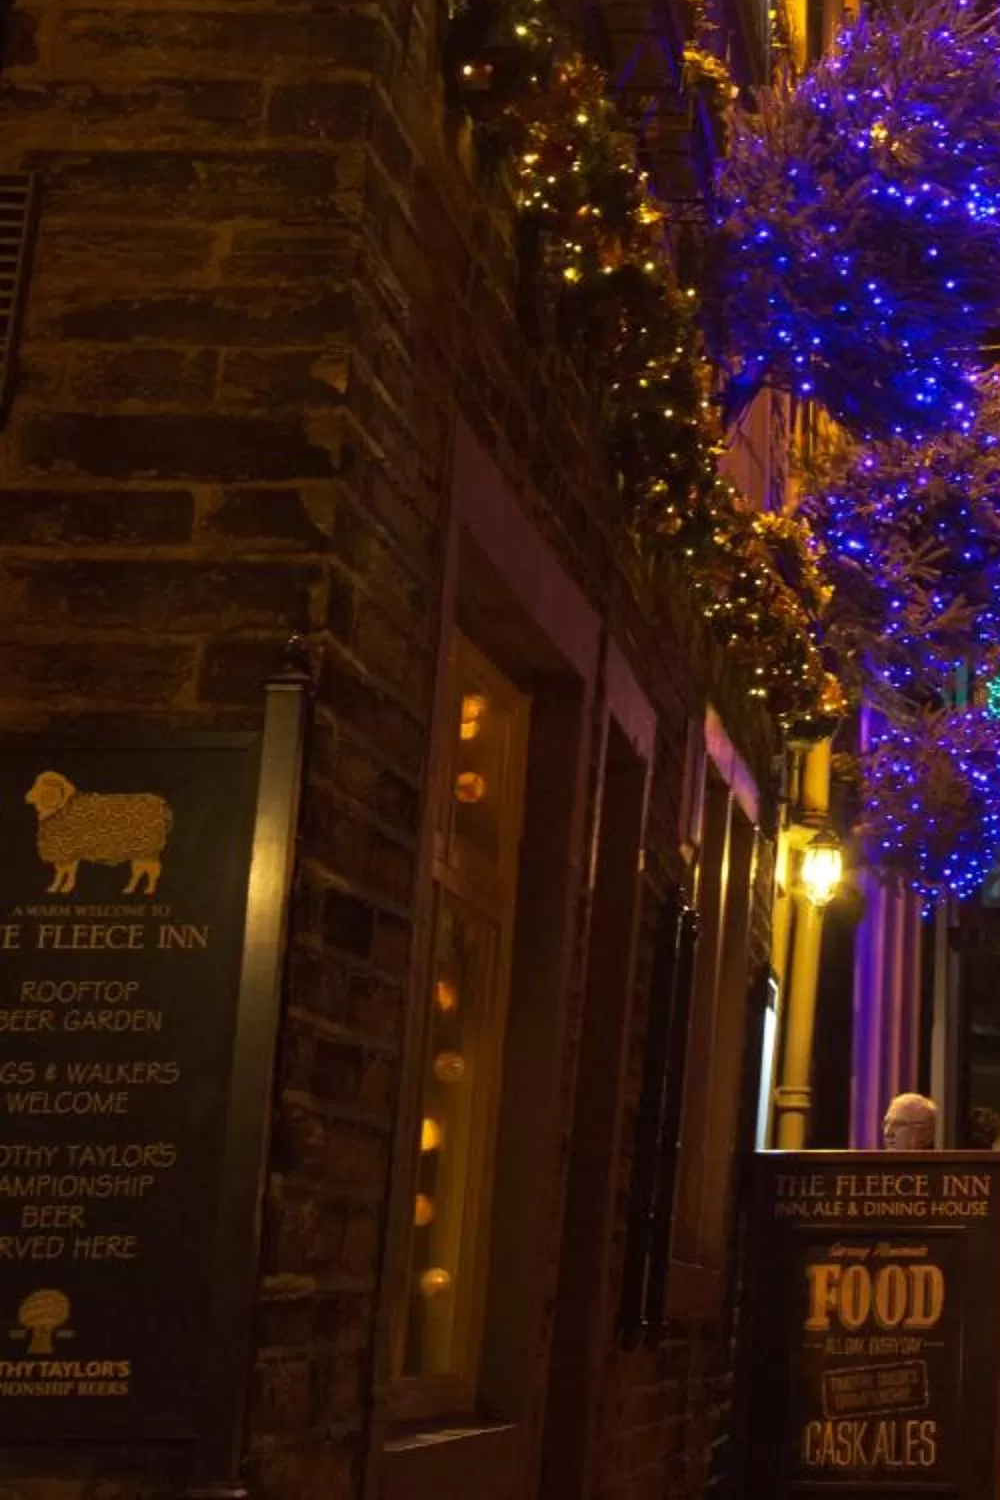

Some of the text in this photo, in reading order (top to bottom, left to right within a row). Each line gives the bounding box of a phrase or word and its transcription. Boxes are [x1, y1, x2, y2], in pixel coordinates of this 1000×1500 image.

[36, 924, 144, 949] FLEECE
[156, 924, 210, 949] INN
[20, 980, 140, 1004] ROOFTOP
[0, 1009, 163, 1032] BEER GARDEN
[67, 1061, 181, 1085] WALKERS
[6, 1091, 129, 1115] WELCOME
[775, 1174, 992, 1198] THE FLEECE INN
[21, 1204, 86, 1229] BEER
[812, 1201, 842, 1217] ALE
[848, 1201, 858, 1216] &
[863, 1200, 927, 1217] DINING
[931, 1200, 989, 1217] HOUSE
[72, 1235, 140, 1260] HERE
[804, 1263, 945, 1331] FOOD
[804, 1419, 937, 1467] CASK ALES
